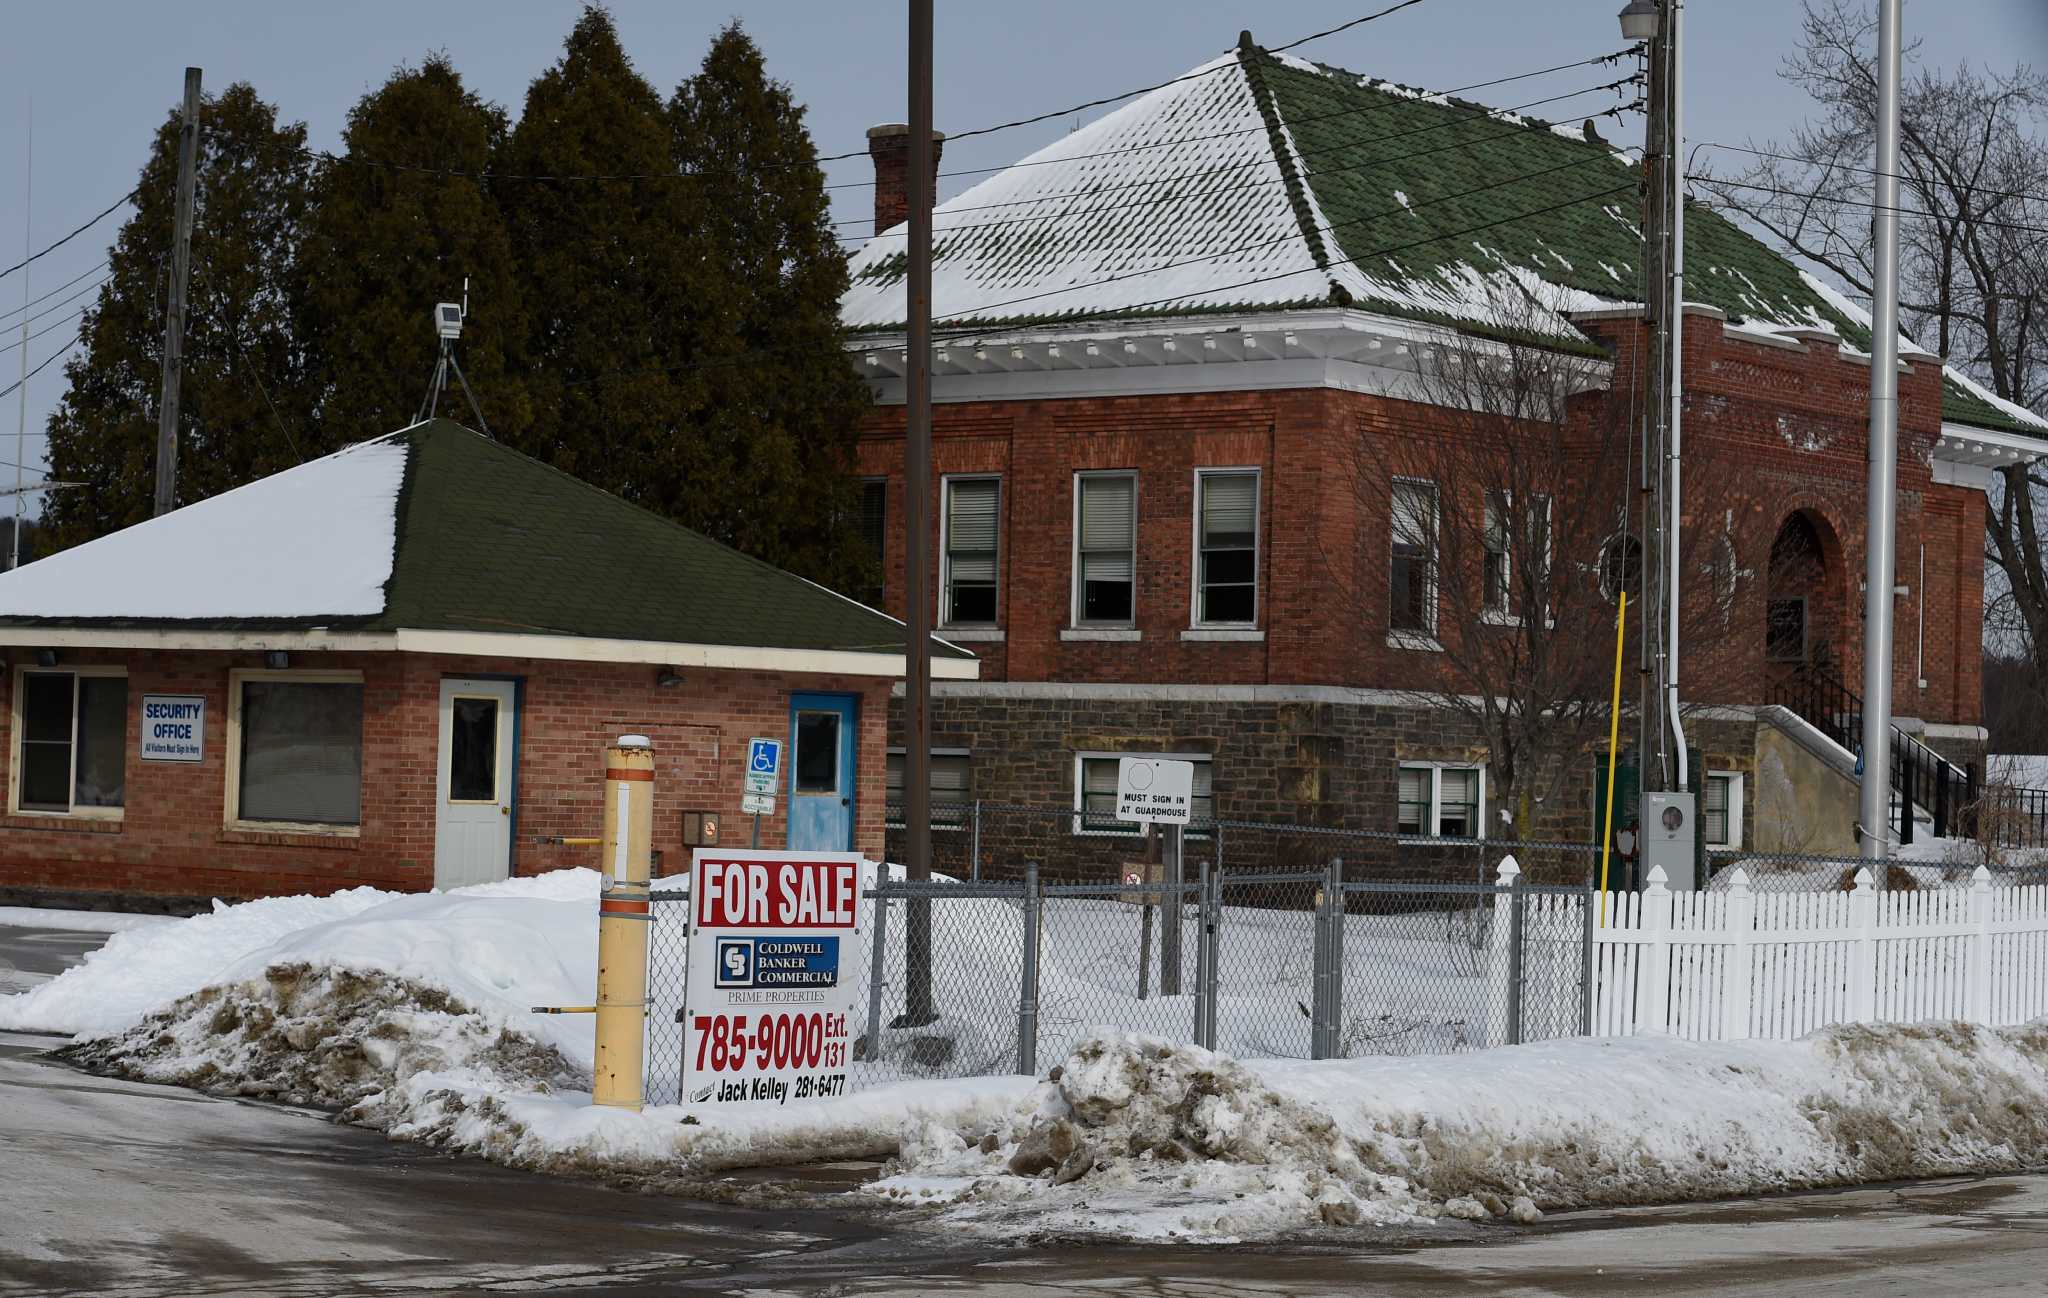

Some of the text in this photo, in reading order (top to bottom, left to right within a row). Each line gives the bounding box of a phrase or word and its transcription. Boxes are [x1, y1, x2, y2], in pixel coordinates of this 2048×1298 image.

[146, 703, 200, 719] SECURITY
[153, 723, 192, 739] OFFICE
[1124, 793, 1185, 804] MUST SIGN IN
[1121, 805, 1187, 817] AT GUARDHOUSE
[702, 863, 853, 925] FOR SALE
[758, 942, 823, 954] COLDWELL
[758, 956, 805, 968] BANKER
[758, 971, 833, 984] COMMERCIAL
[728, 991, 825, 1002] PRIME PROPERTIES
[694, 1012, 848, 1072] 785-9000 Ext.
[823, 1042, 846, 1068] 131
[690, 1074, 846, 1105] Contact Jack Kelley 281-6477
